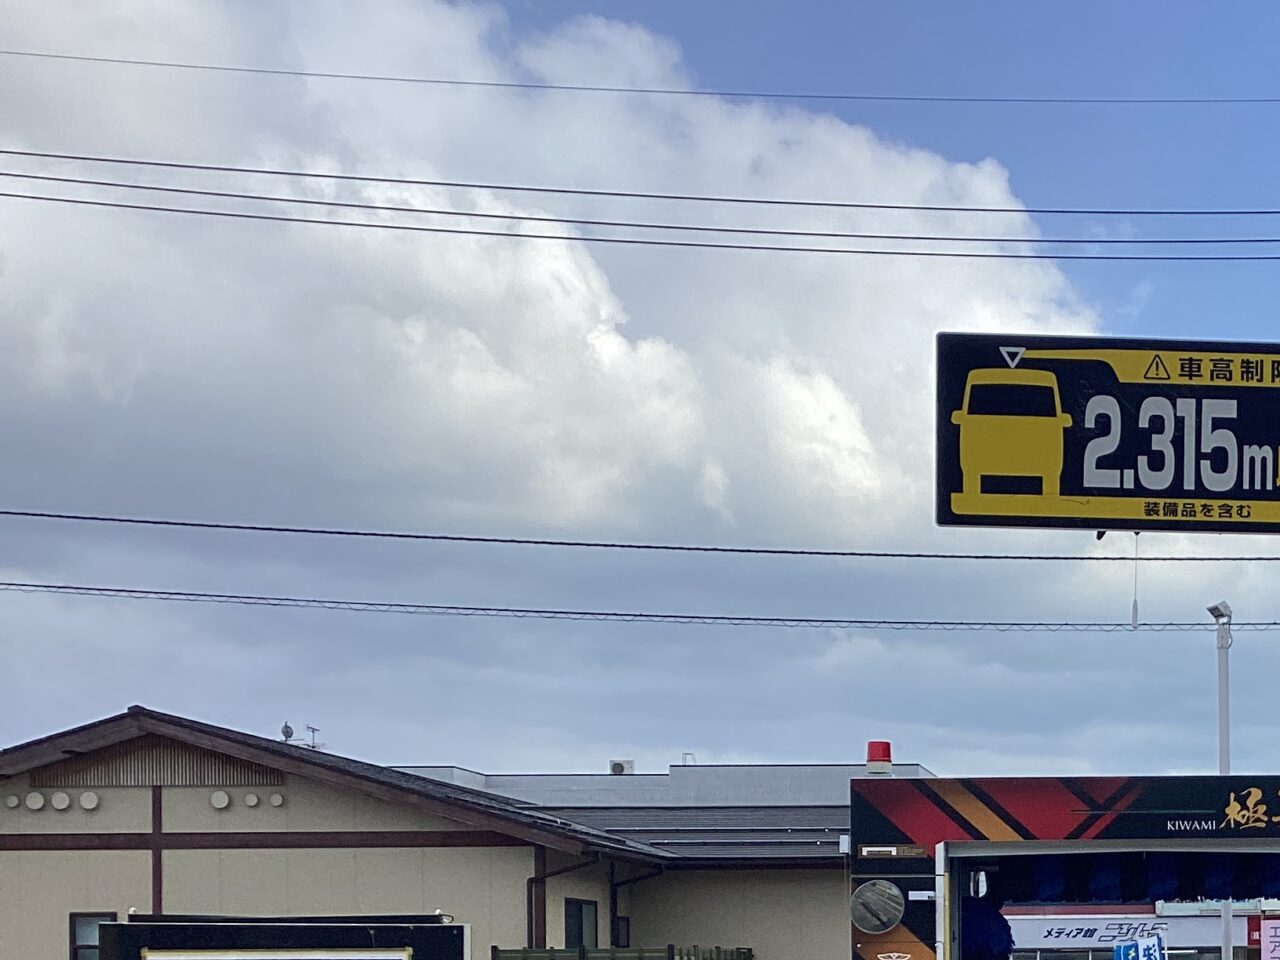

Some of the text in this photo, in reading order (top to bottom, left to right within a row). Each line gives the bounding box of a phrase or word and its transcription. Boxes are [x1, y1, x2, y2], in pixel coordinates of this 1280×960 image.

[1144, 502, 1251, 518] 装備品を含む
[1167, 820, 1216, 831] KIWAMI
[1043, 927, 1098, 939] メディア館
